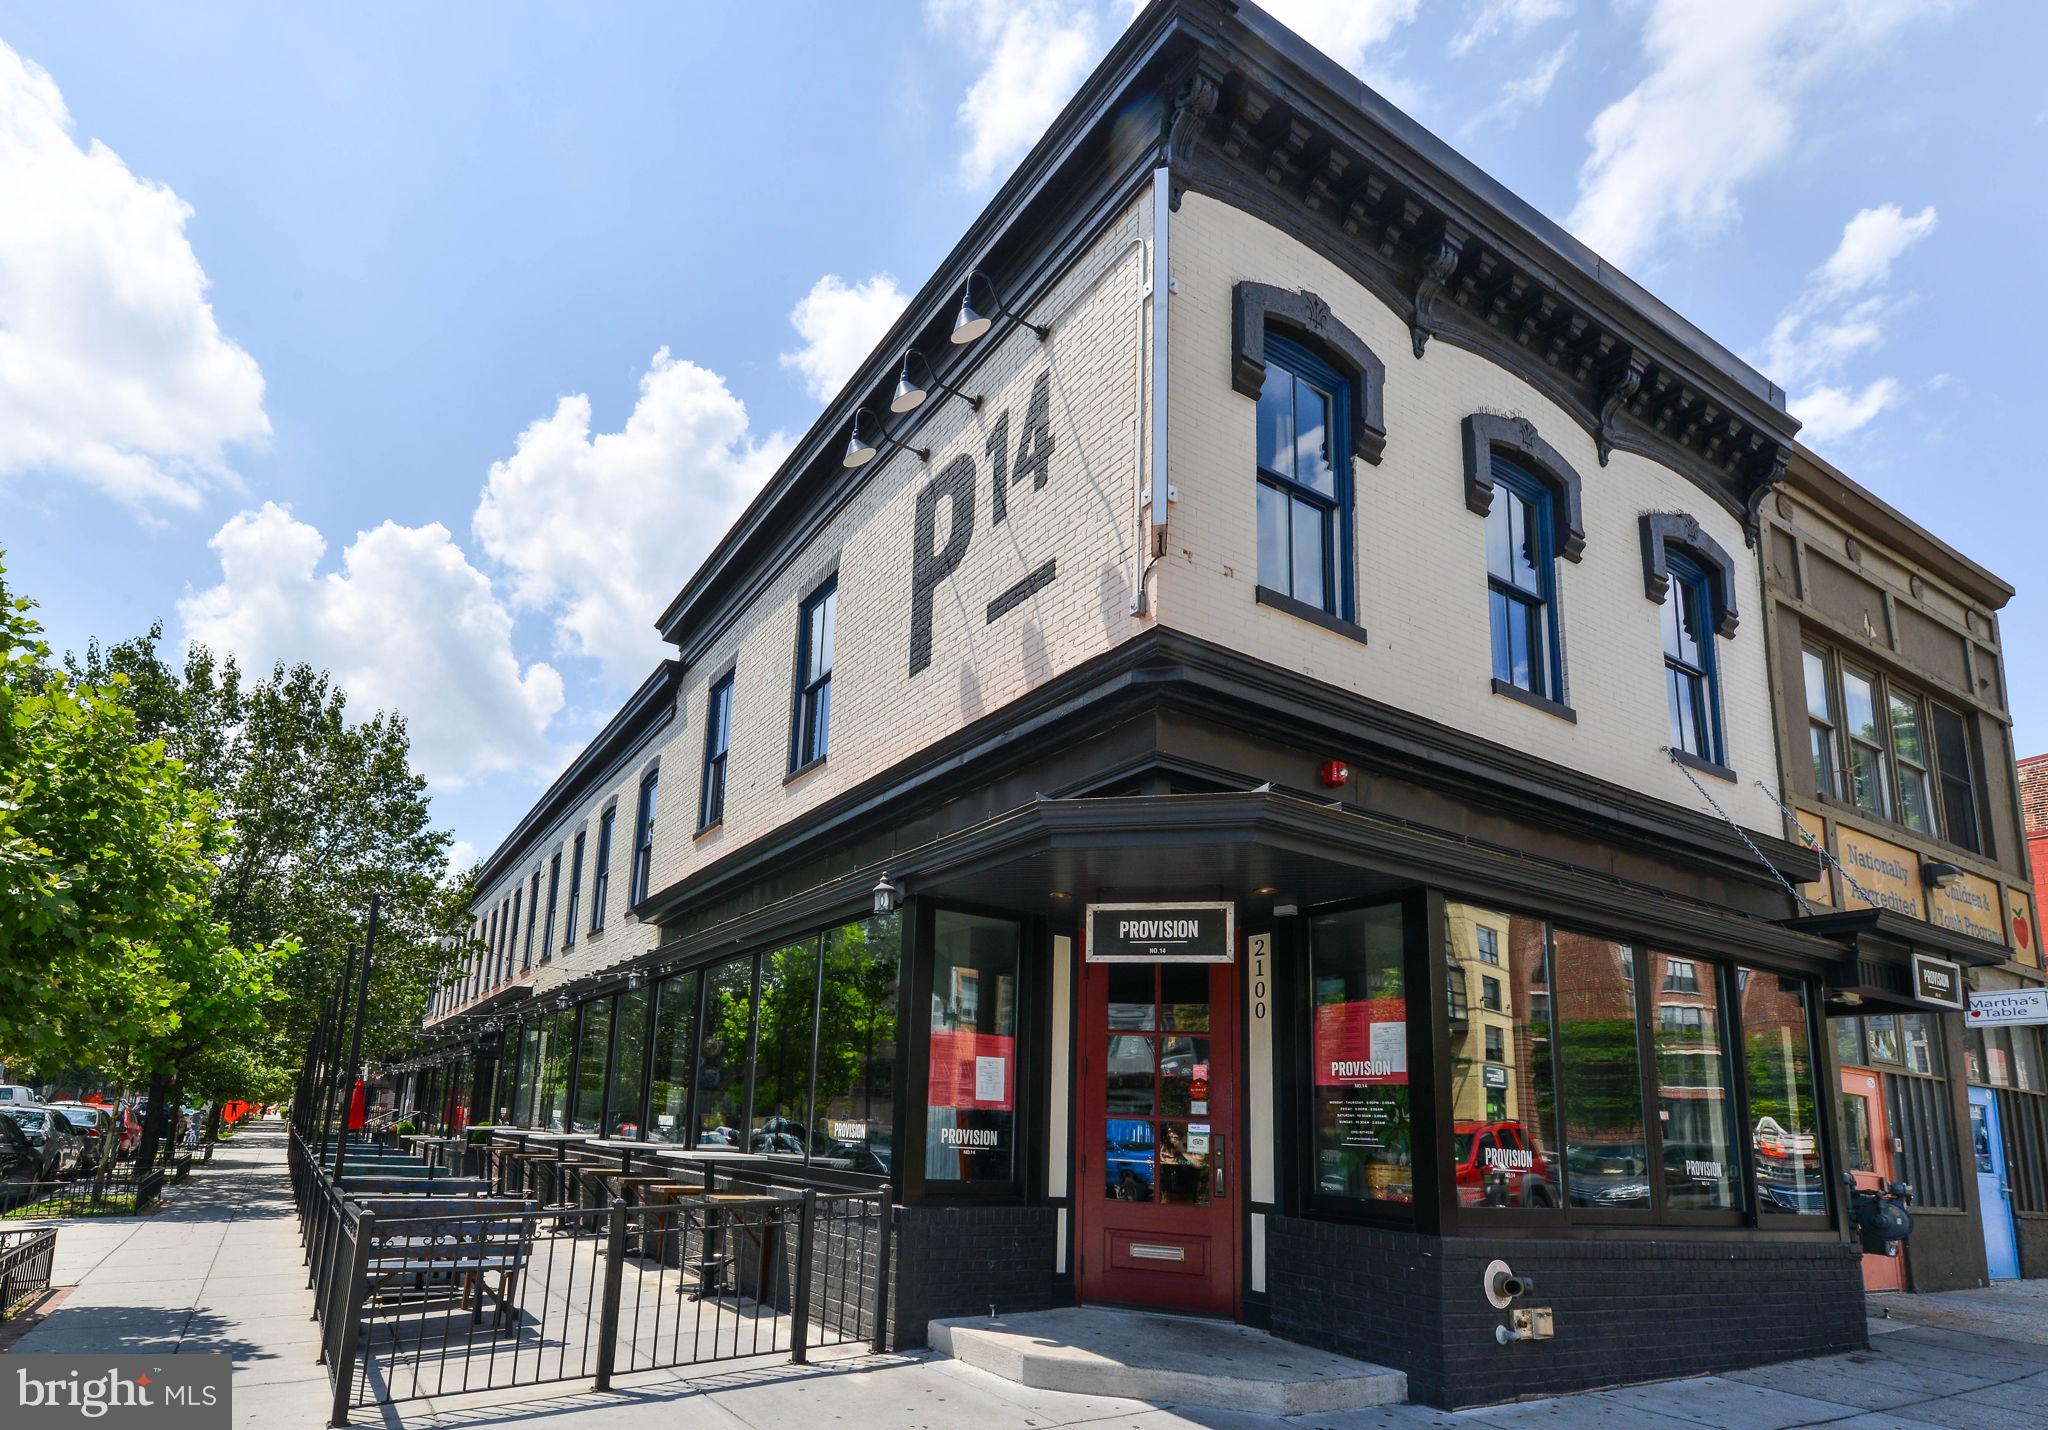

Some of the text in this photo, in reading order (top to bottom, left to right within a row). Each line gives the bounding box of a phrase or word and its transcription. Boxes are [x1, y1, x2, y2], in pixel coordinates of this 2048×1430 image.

[1847, 844, 1908, 887] Nationally
[1983, 893, 1991, 912] &
[1119, 920, 1199, 939] PROVISION
[1254, 939, 1266, 1019] 2100
[1923, 969, 1950, 988] PROVISION
[1969, 996, 2040, 1009] Martha's
[1982, 1007, 2028, 1018] Table
[1331, 1060, 1391, 1076] PROVISION
[834, 1122, 866, 1139] PROVISION
[941, 1128, 998, 1146] PROVISION
[1485, 1147, 1532, 1168] PROVISION
[1685, 1160, 1722, 1177] PROVISION
